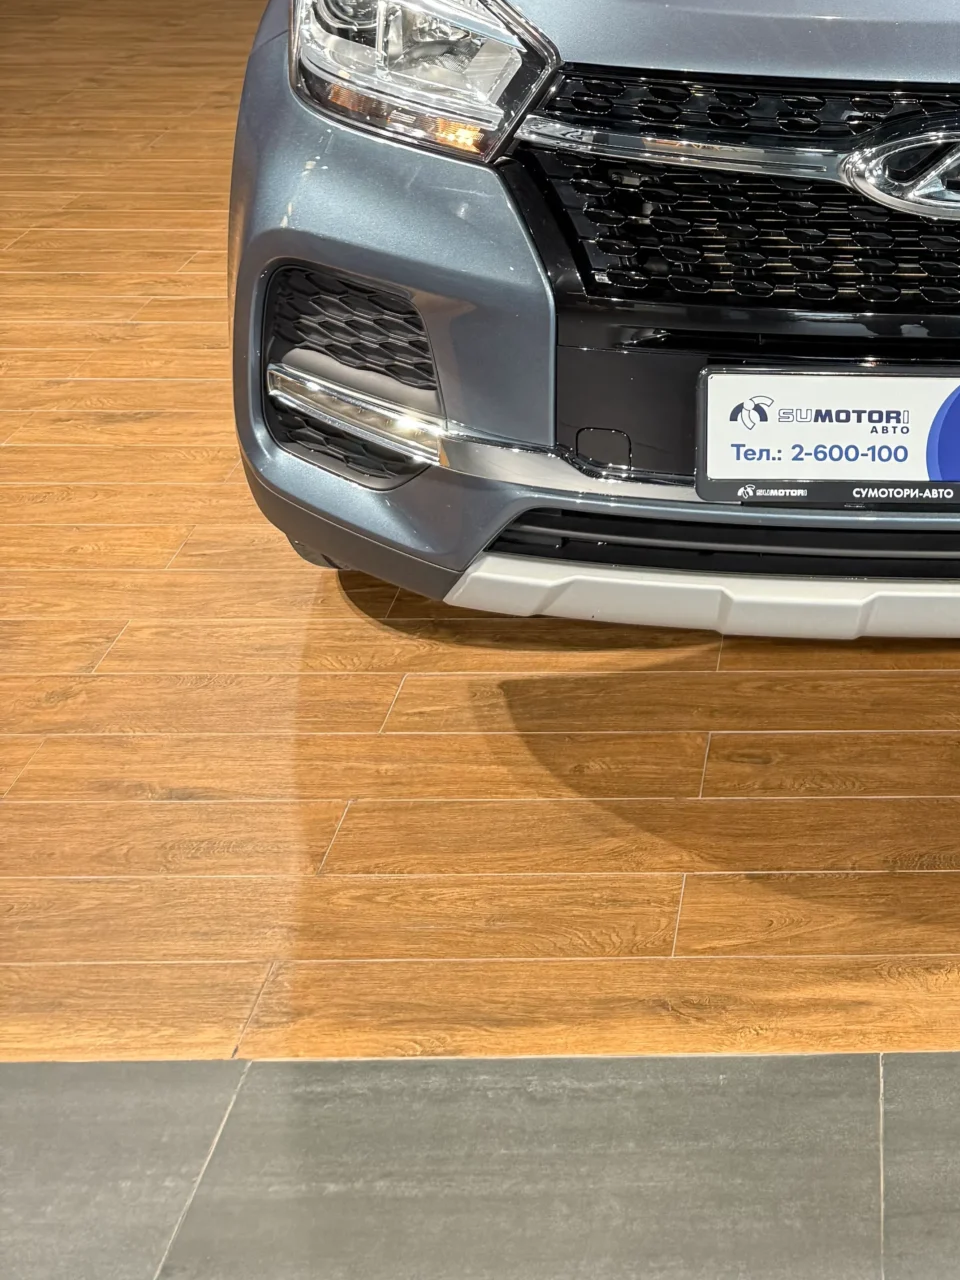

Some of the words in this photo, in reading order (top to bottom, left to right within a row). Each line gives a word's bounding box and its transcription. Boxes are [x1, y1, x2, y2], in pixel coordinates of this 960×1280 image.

[778, 408, 910, 424] SUMOTORI
[870, 425, 910, 435] АВТО
[730, 443, 783, 461] Тел.:
[791, 444, 909, 463] 2-600-100
[852, 487, 954, 499] СУМОТОРИ-АВТО
